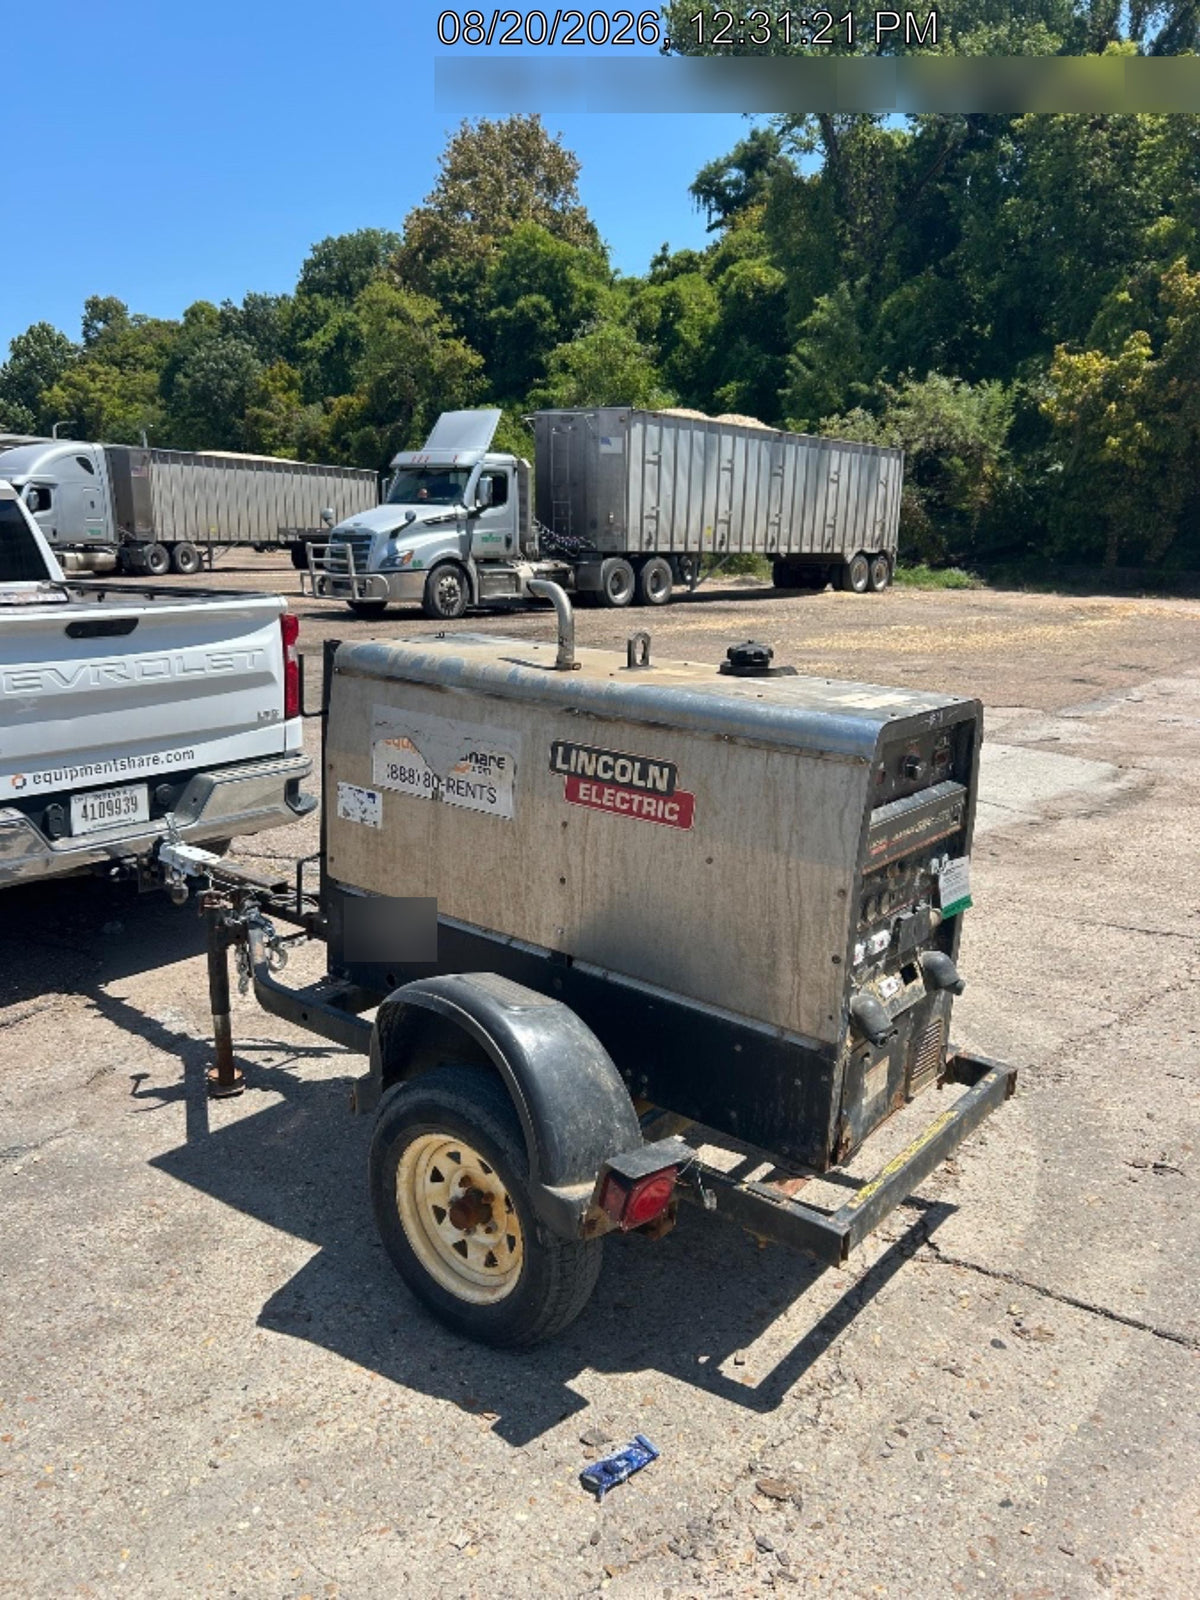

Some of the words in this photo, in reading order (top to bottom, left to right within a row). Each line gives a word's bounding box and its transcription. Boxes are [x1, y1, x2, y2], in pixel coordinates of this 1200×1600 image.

[31, 749, 195, 786] equipmentshare.com
[555, 745, 670, 792] LINCOLN
[578, 782, 681, 822] ELECTRIC
